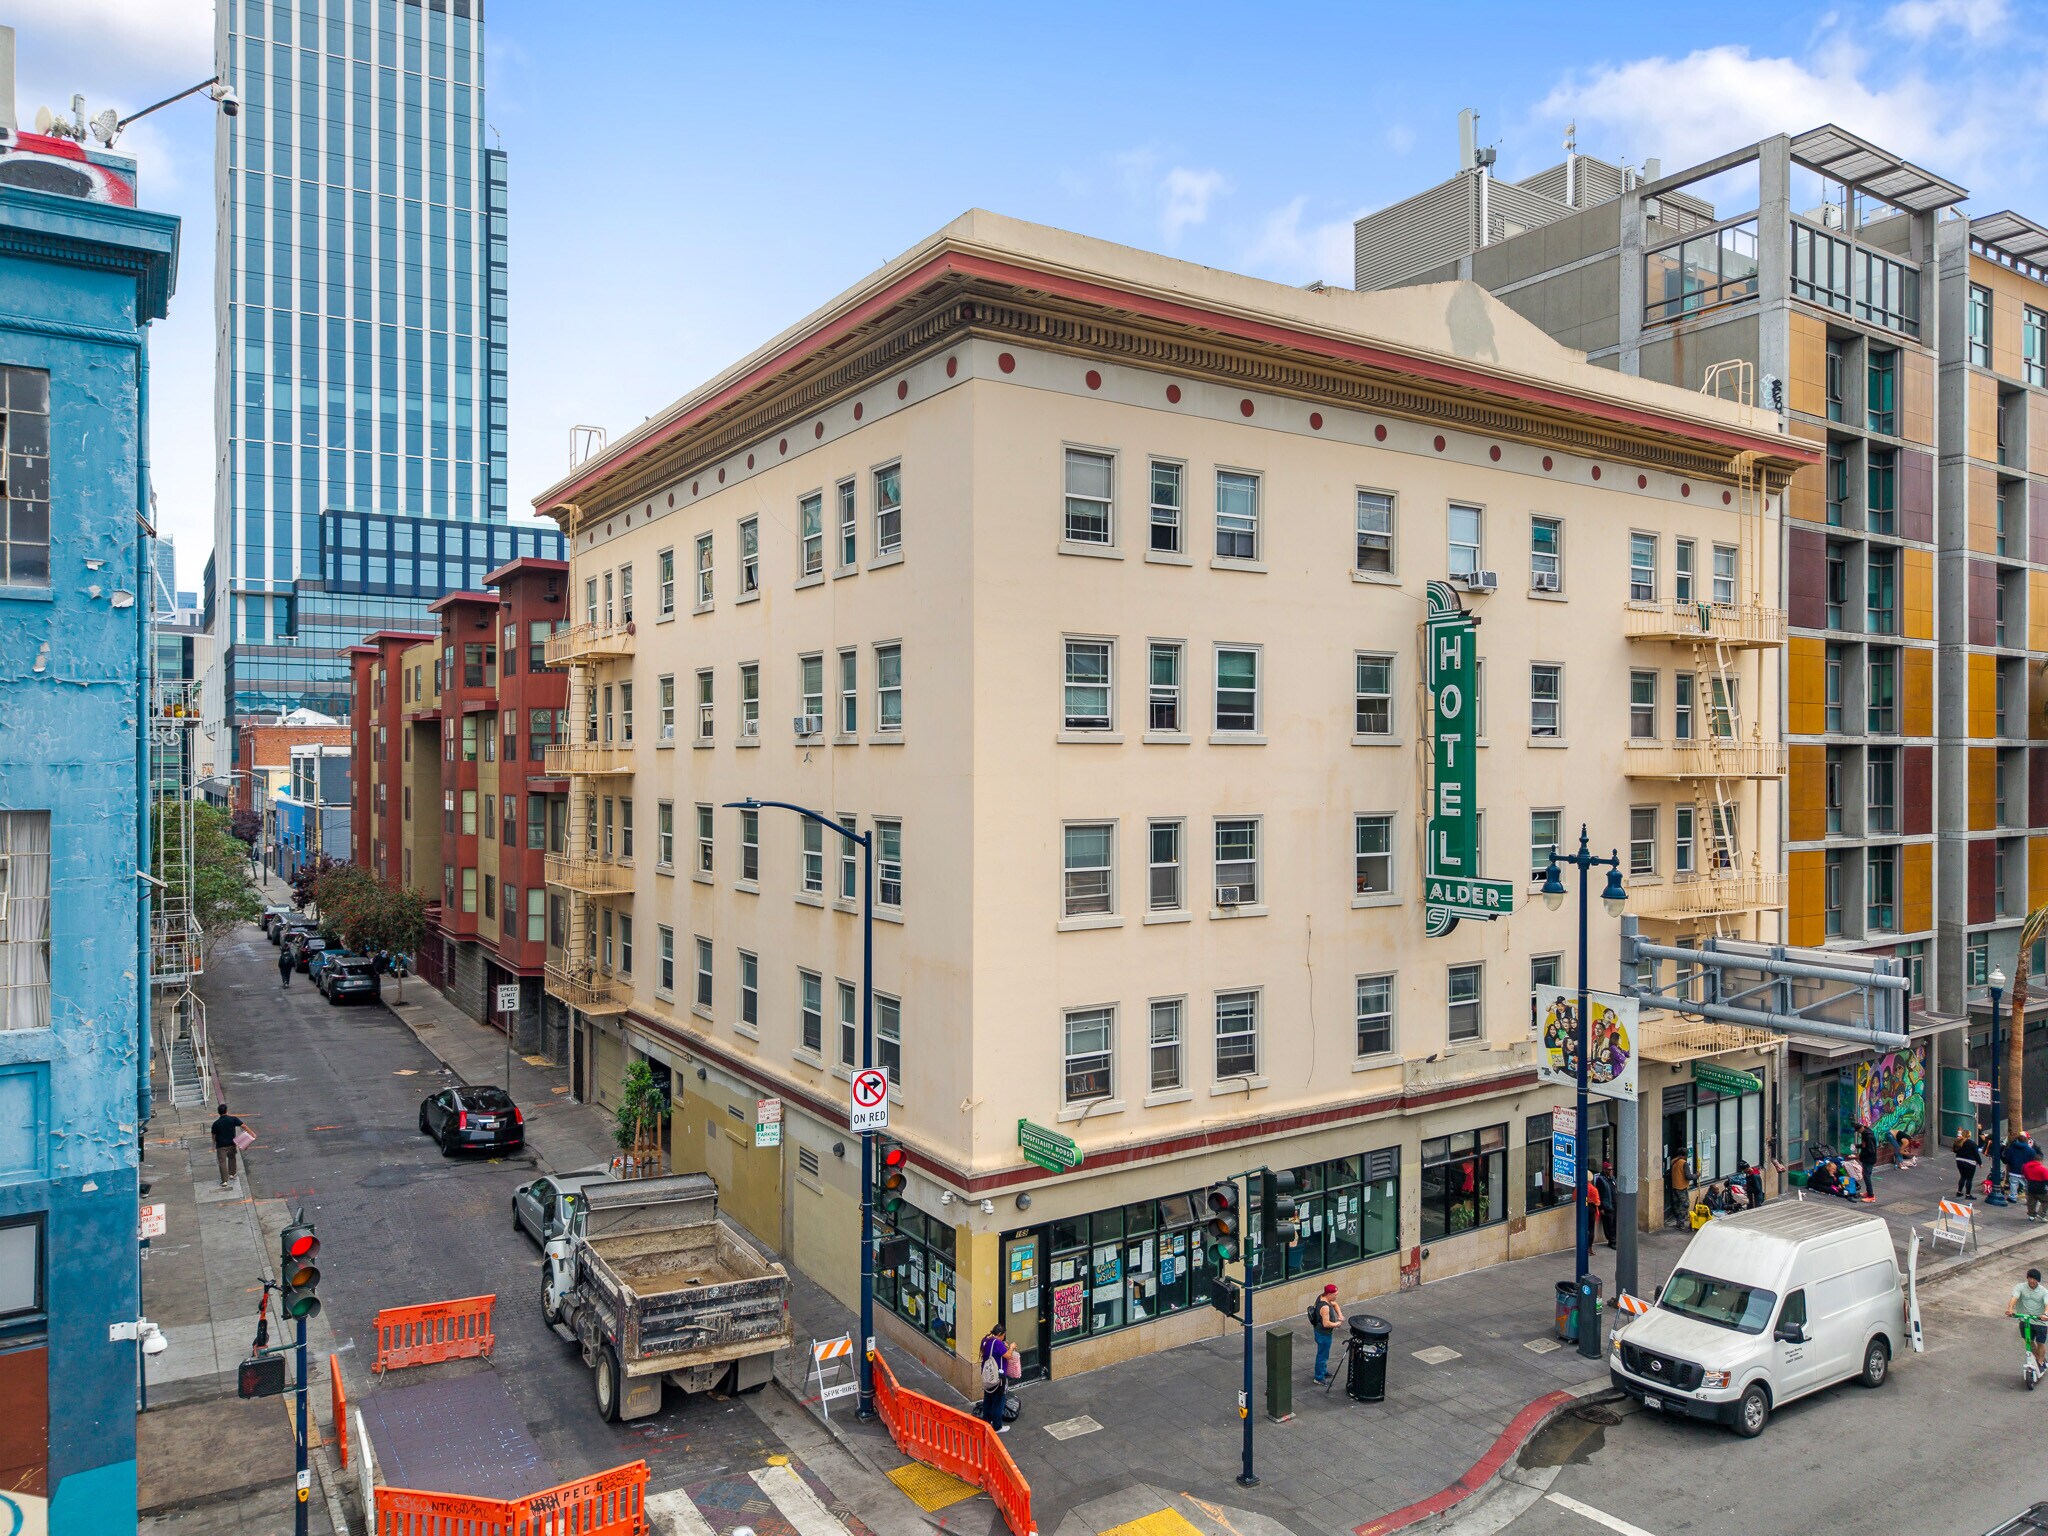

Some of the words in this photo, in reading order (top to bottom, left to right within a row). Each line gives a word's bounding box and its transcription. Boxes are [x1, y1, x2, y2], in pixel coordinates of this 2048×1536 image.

[1440, 635, 1462, 866] HOTEL
[1428, 882, 1500, 908] ALDER
[501, 999, 515, 1009] 15
[1697, 1068, 1734, 1081] HOSPITALITY
[1736, 1078, 1756, 1086] HOUSE
[853, 1114, 866, 1124] ON
[869, 1111, 886, 1121] RED
[1561, 1108, 1576, 1117] PARKING
[1022, 1131, 1054, 1150] HOSPITALITY
[1055, 1146, 1073, 1159] HOUSE
[142, 1208, 150, 1216] NO
[143, 1214, 164, 1223] PARKING
[431, 1502, 453, 1513] NTK
